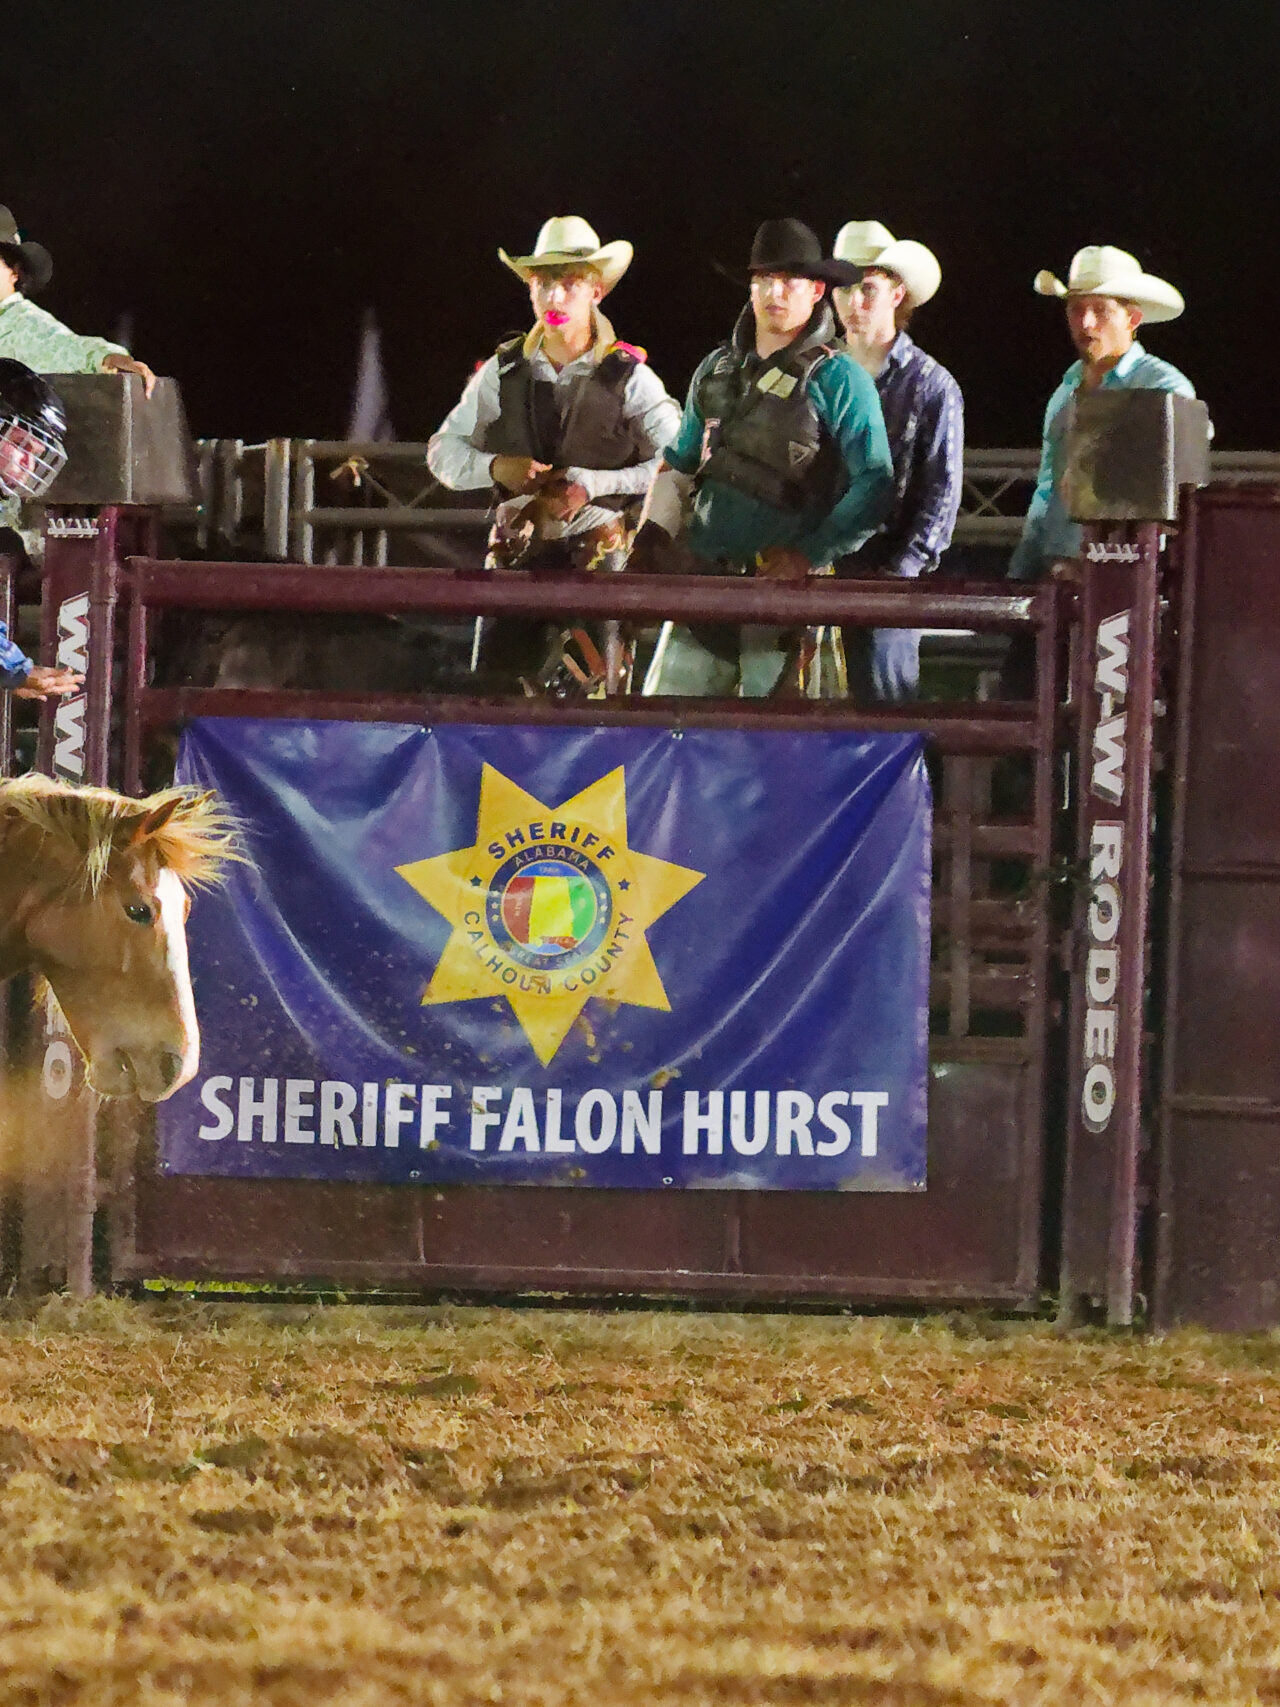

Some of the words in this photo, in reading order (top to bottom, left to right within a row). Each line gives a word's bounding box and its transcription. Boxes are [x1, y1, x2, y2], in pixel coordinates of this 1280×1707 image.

[488, 822, 616, 862] SHERIFF
[515, 846, 589, 871] ALABAMA
[464, 911, 551, 994] CALHOUN
[564, 911, 634, 992] COUNTY
[1083, 821, 1123, 1130] RODEO
[198, 1075, 453, 1150] SHERIFF
[470, 1086, 663, 1155] FALON
[682, 1090, 889, 1157] HURST
